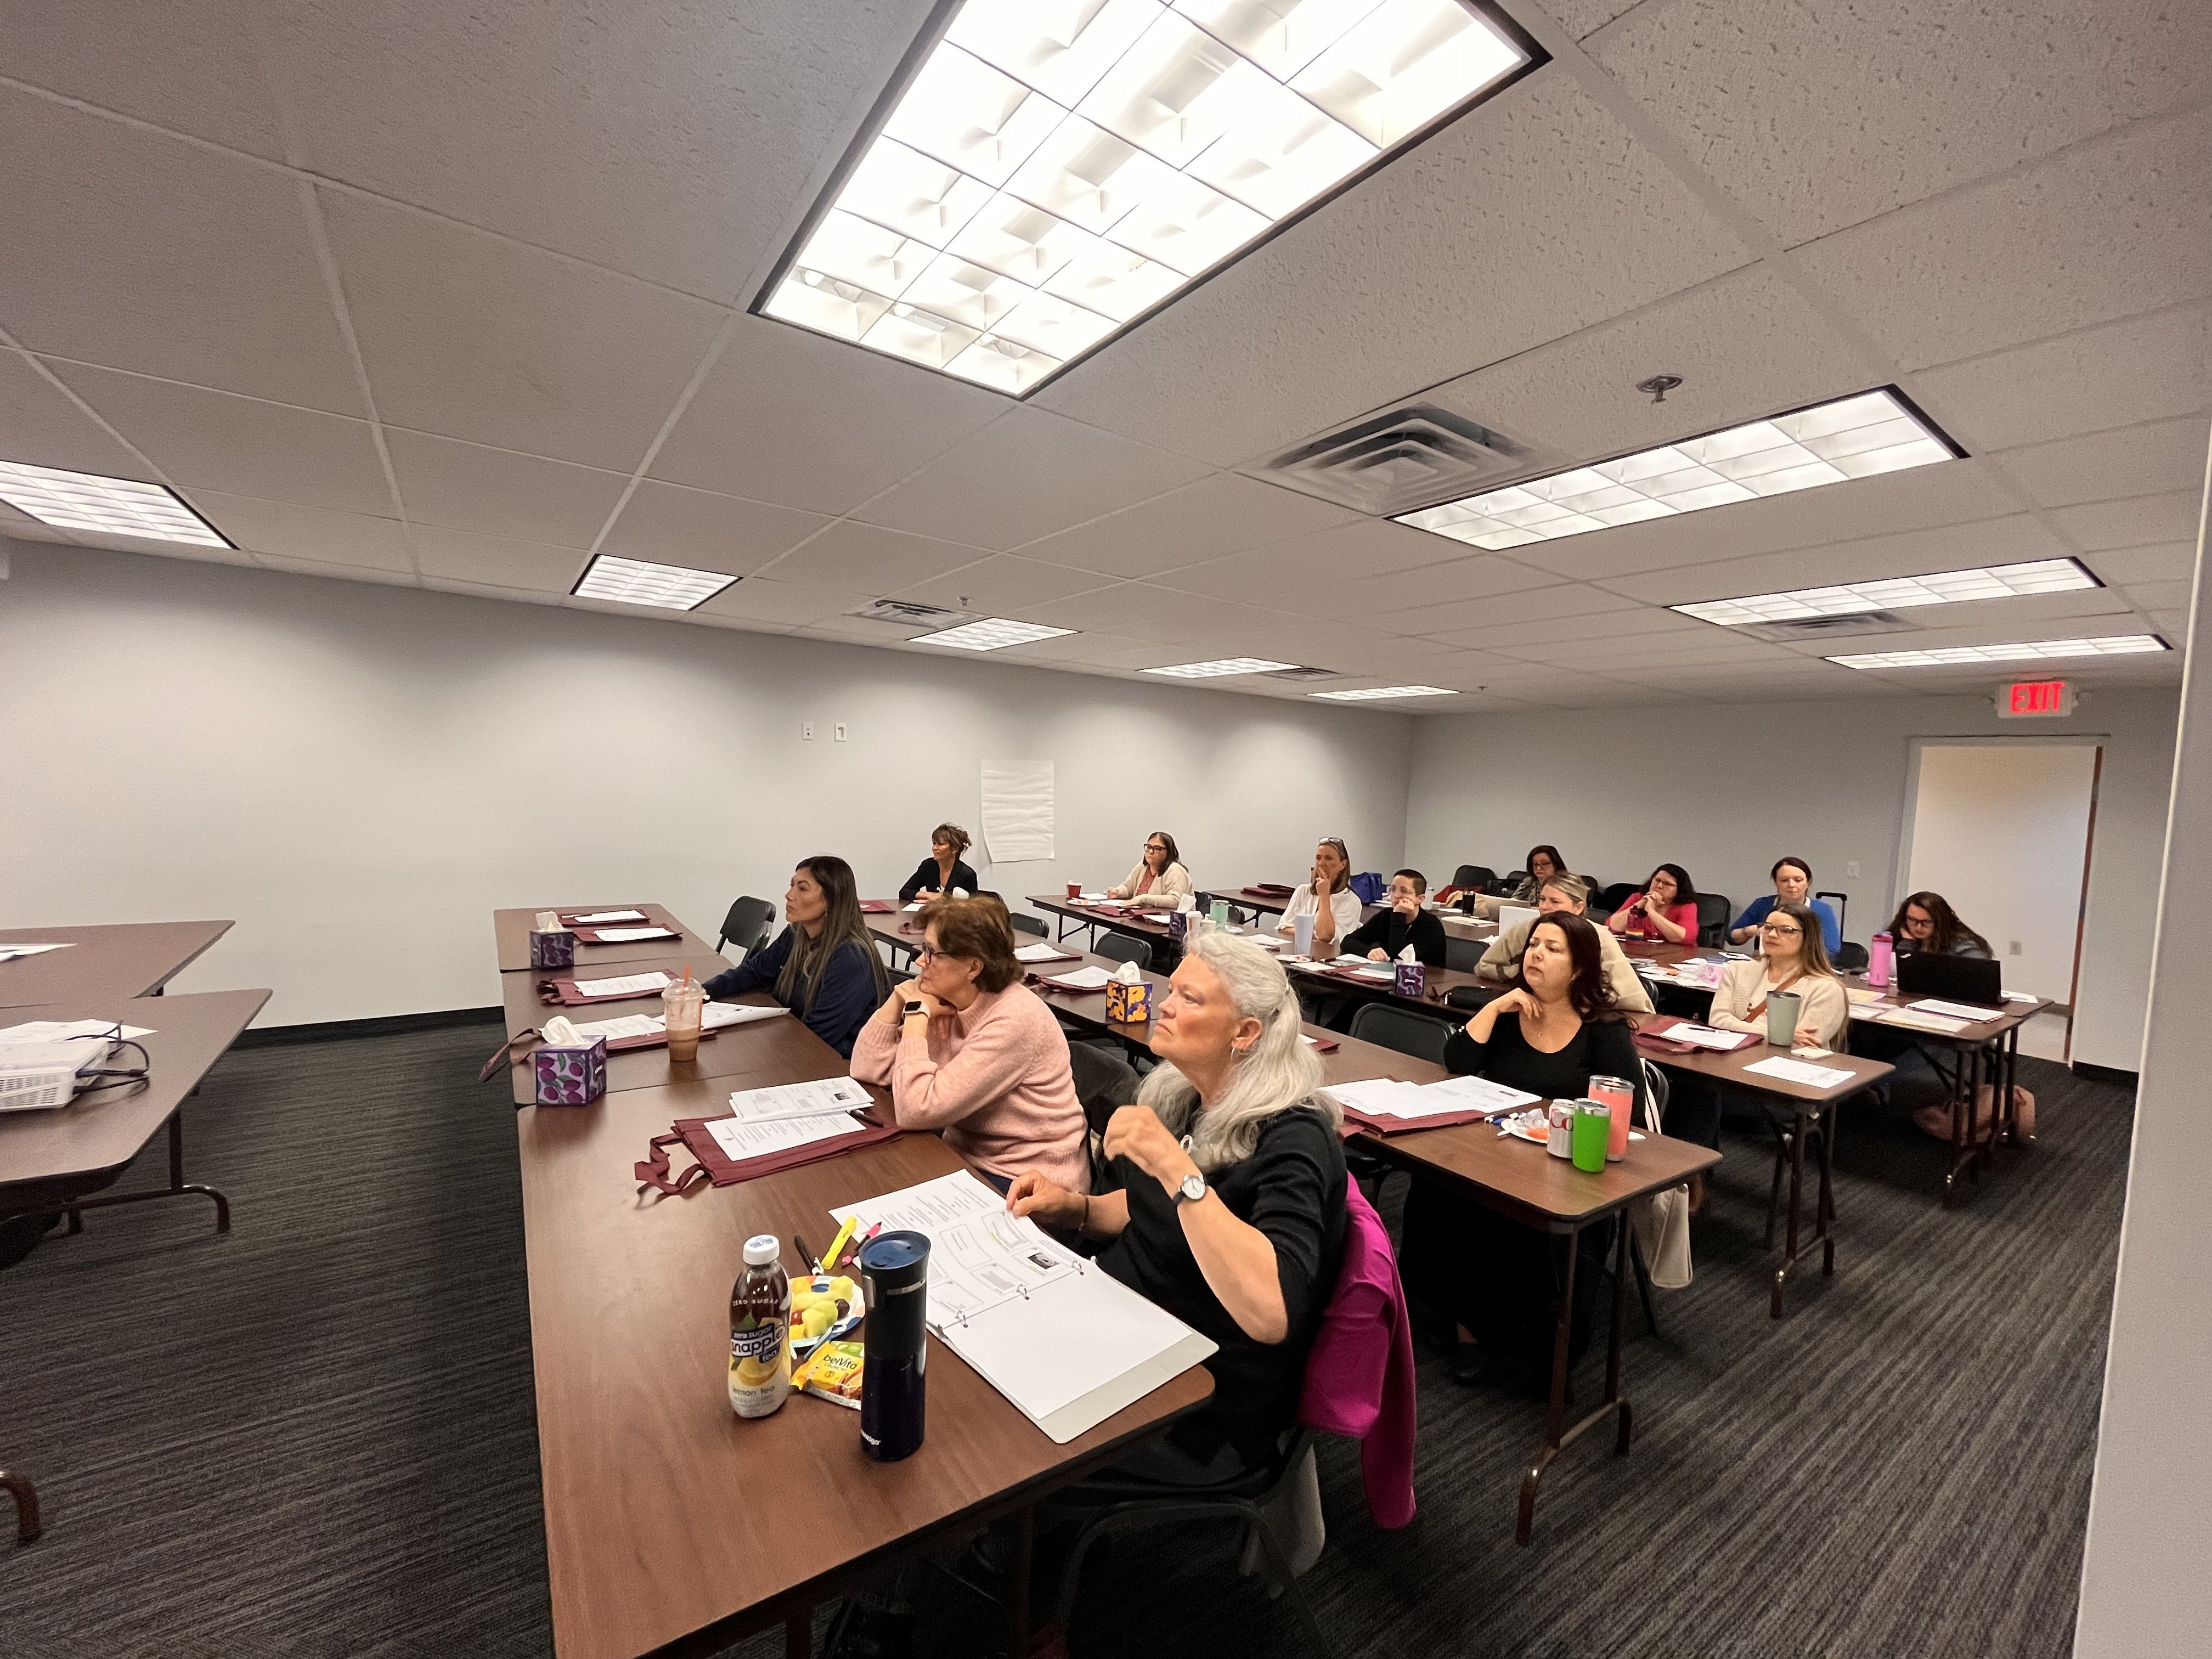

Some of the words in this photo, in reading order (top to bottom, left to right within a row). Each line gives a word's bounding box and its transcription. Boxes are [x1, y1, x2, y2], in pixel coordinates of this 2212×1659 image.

[2010, 682, 2065, 713] EXIT
[731, 1327, 785, 1356] snapple
[823, 1354, 857, 1370] belVita
[733, 1385, 757, 1396] lemon
[760, 1385, 775, 1395] tea
